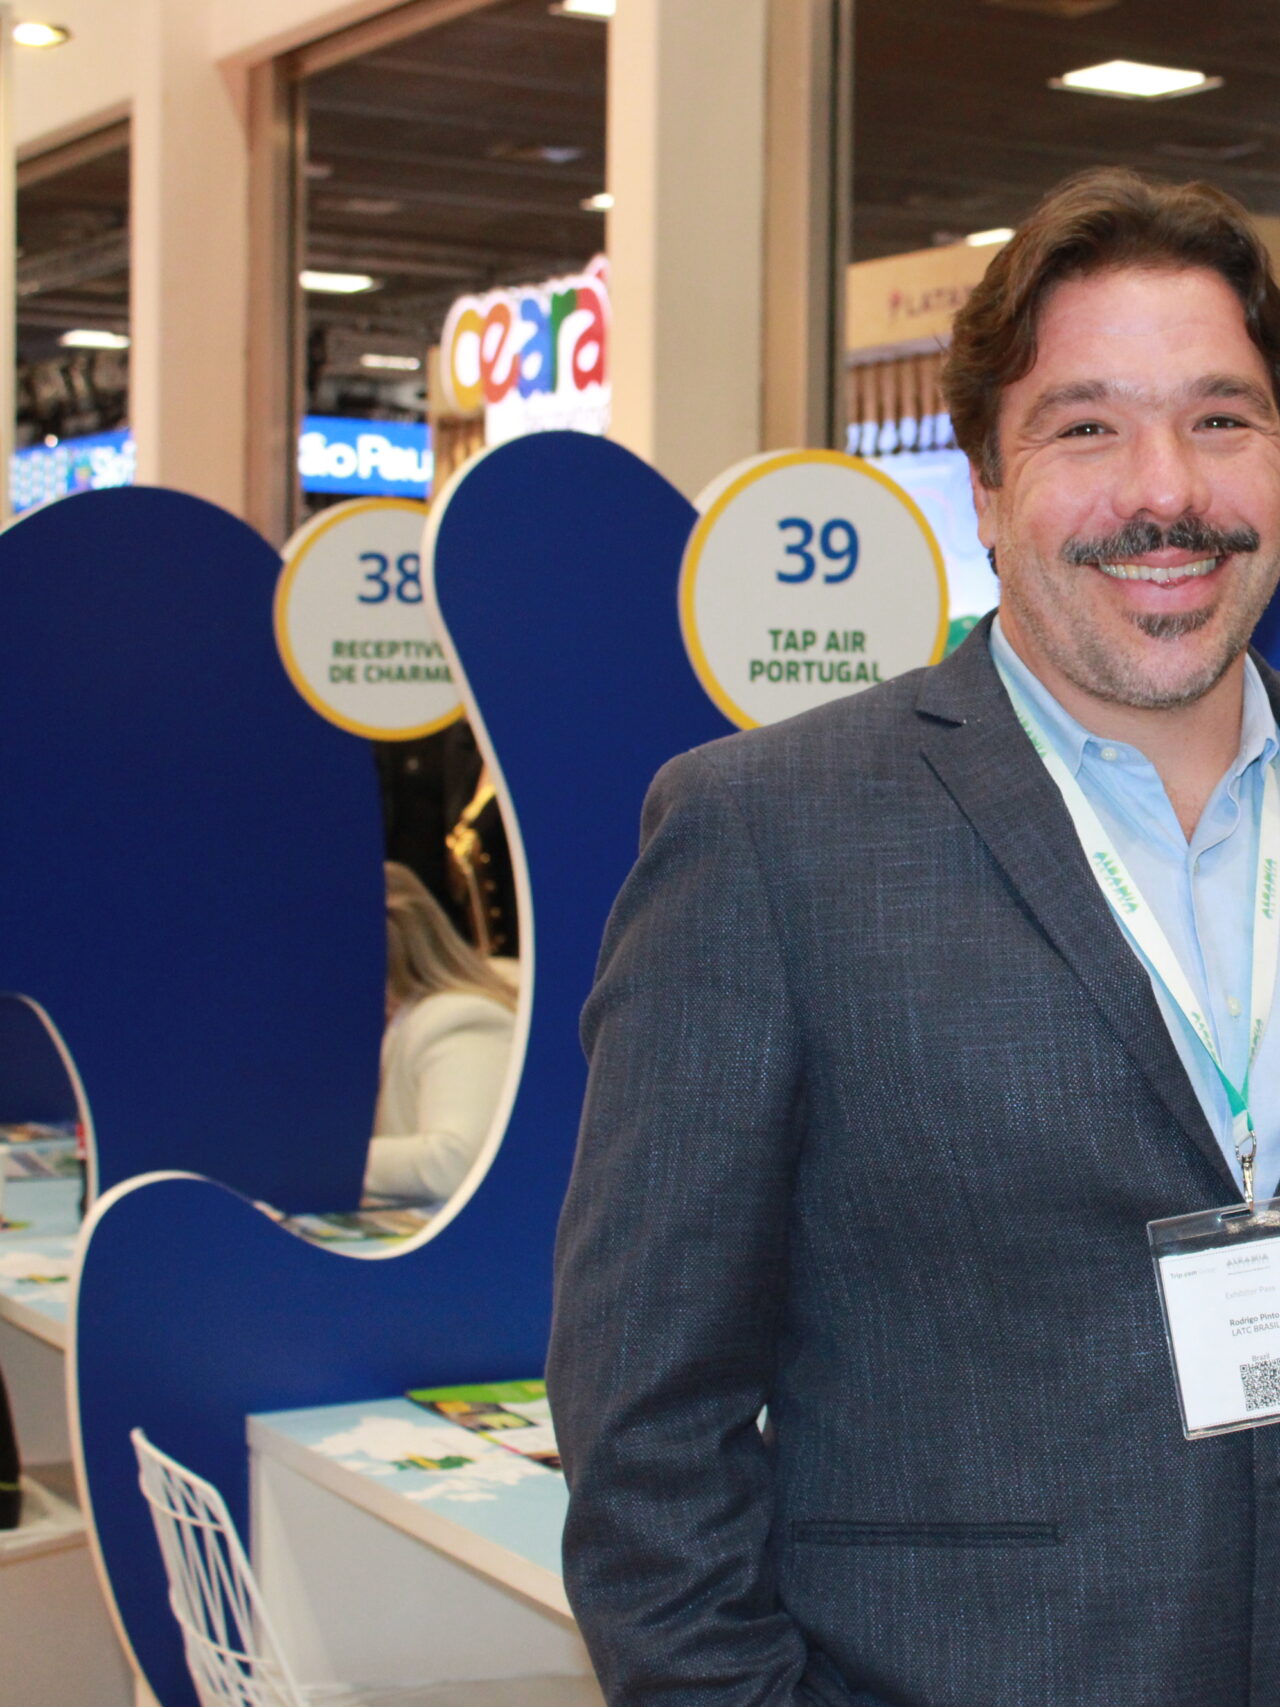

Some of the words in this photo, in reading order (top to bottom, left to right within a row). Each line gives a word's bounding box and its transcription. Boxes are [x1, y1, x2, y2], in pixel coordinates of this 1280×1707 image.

[776, 517, 860, 584] 39
[357, 552, 423, 604] 38
[768, 629, 817, 652] TAP
[825, 630, 866, 653] AIR
[328, 665, 354, 683] DE
[749, 660, 884, 683] PORTUGAL
[1229, 1315, 1259, 1327] Rodrigo
[1260, 1312, 1280, 1321] Pinto
[1231, 1326, 1252, 1337] LATC
[1253, 1321, 1280, 1333] BRASIL
